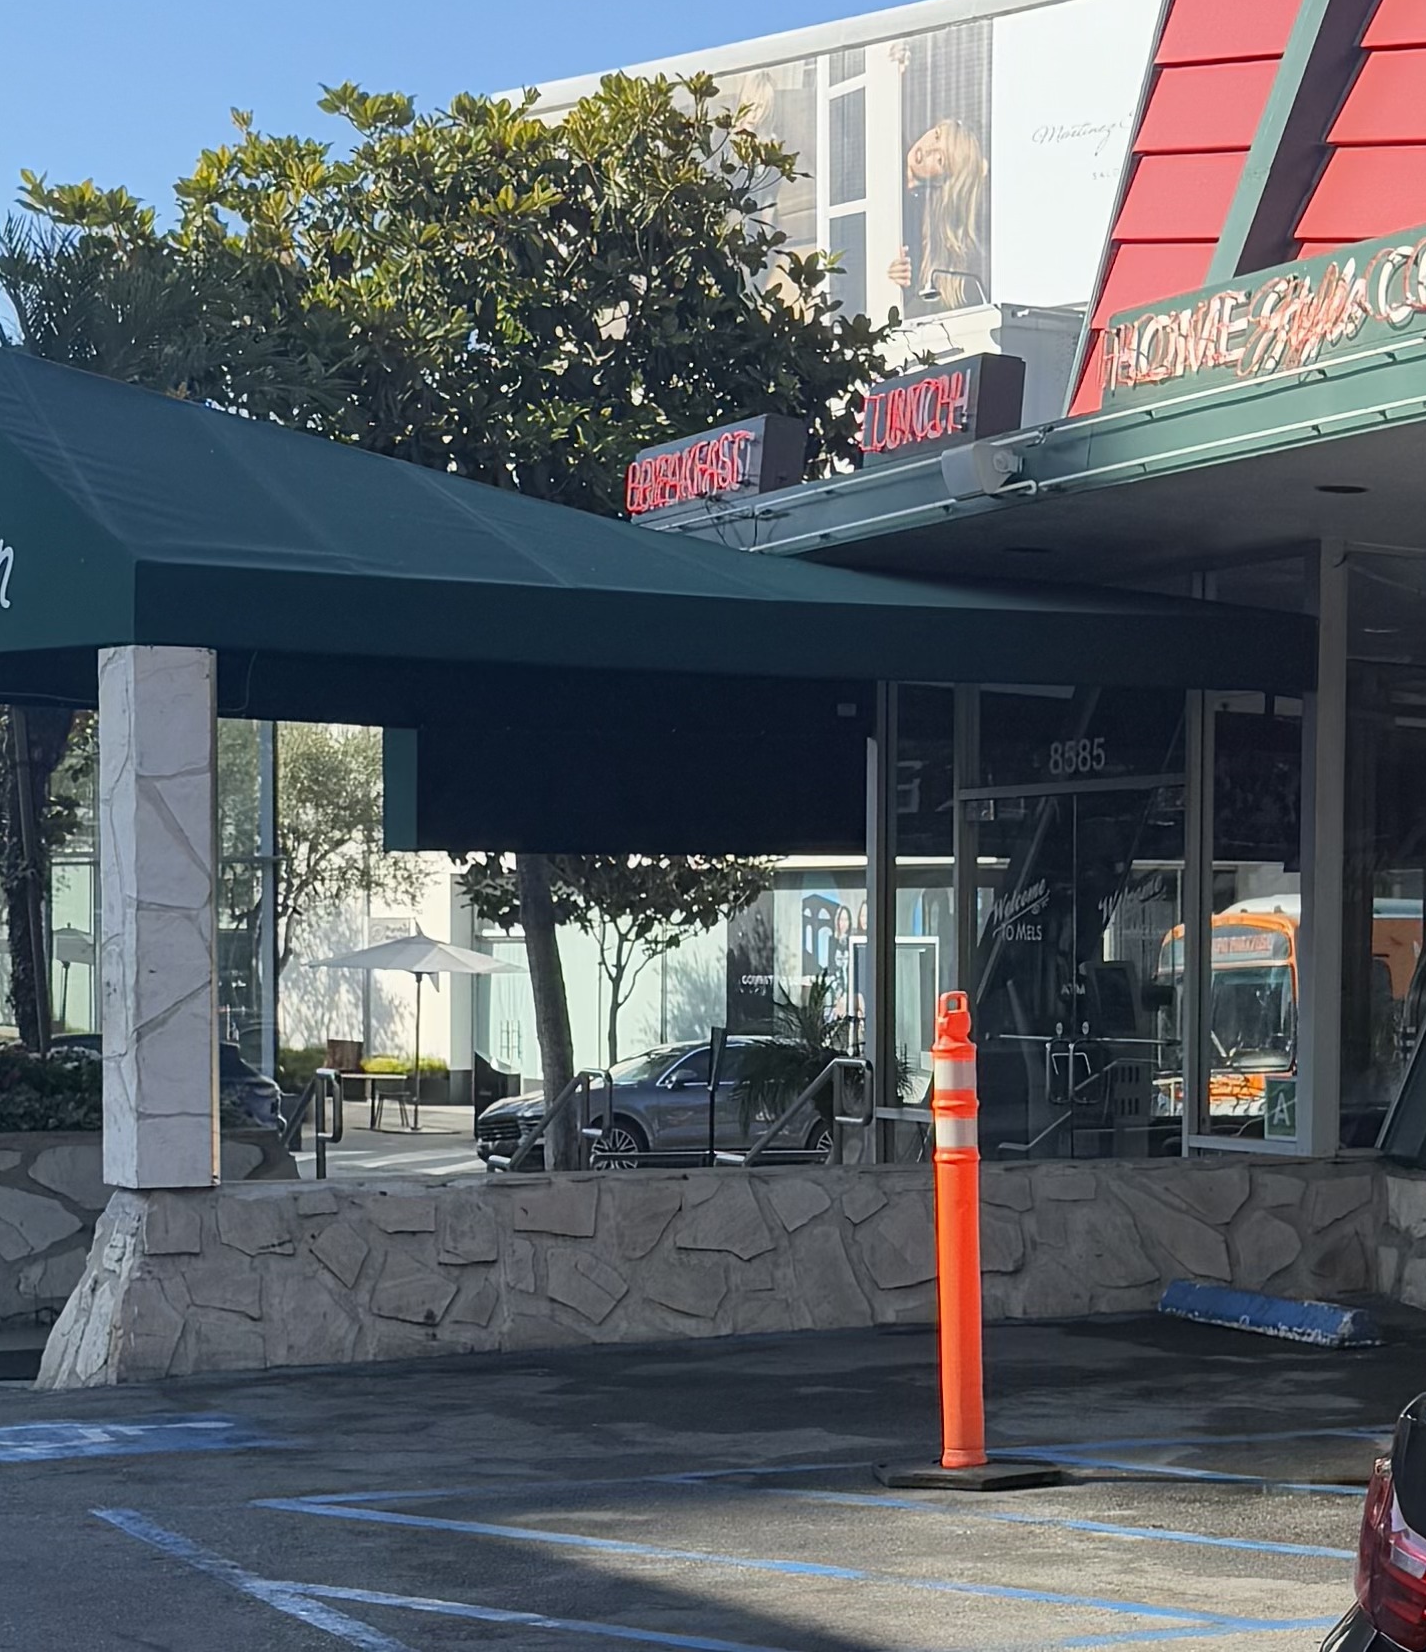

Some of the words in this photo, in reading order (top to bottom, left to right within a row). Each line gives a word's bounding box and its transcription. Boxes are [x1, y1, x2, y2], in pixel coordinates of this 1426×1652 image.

[1102, 290, 1250, 390] HOME
[860, 368, 972, 452] LUNCH
[626, 429, 756, 515] BREAKFAST
[1050, 738, 1106, 774] 8585
[993, 878, 1046, 925] Welcome
[1015, 922, 1043, 941] MELS
[1272, 1091, 1291, 1126] A
